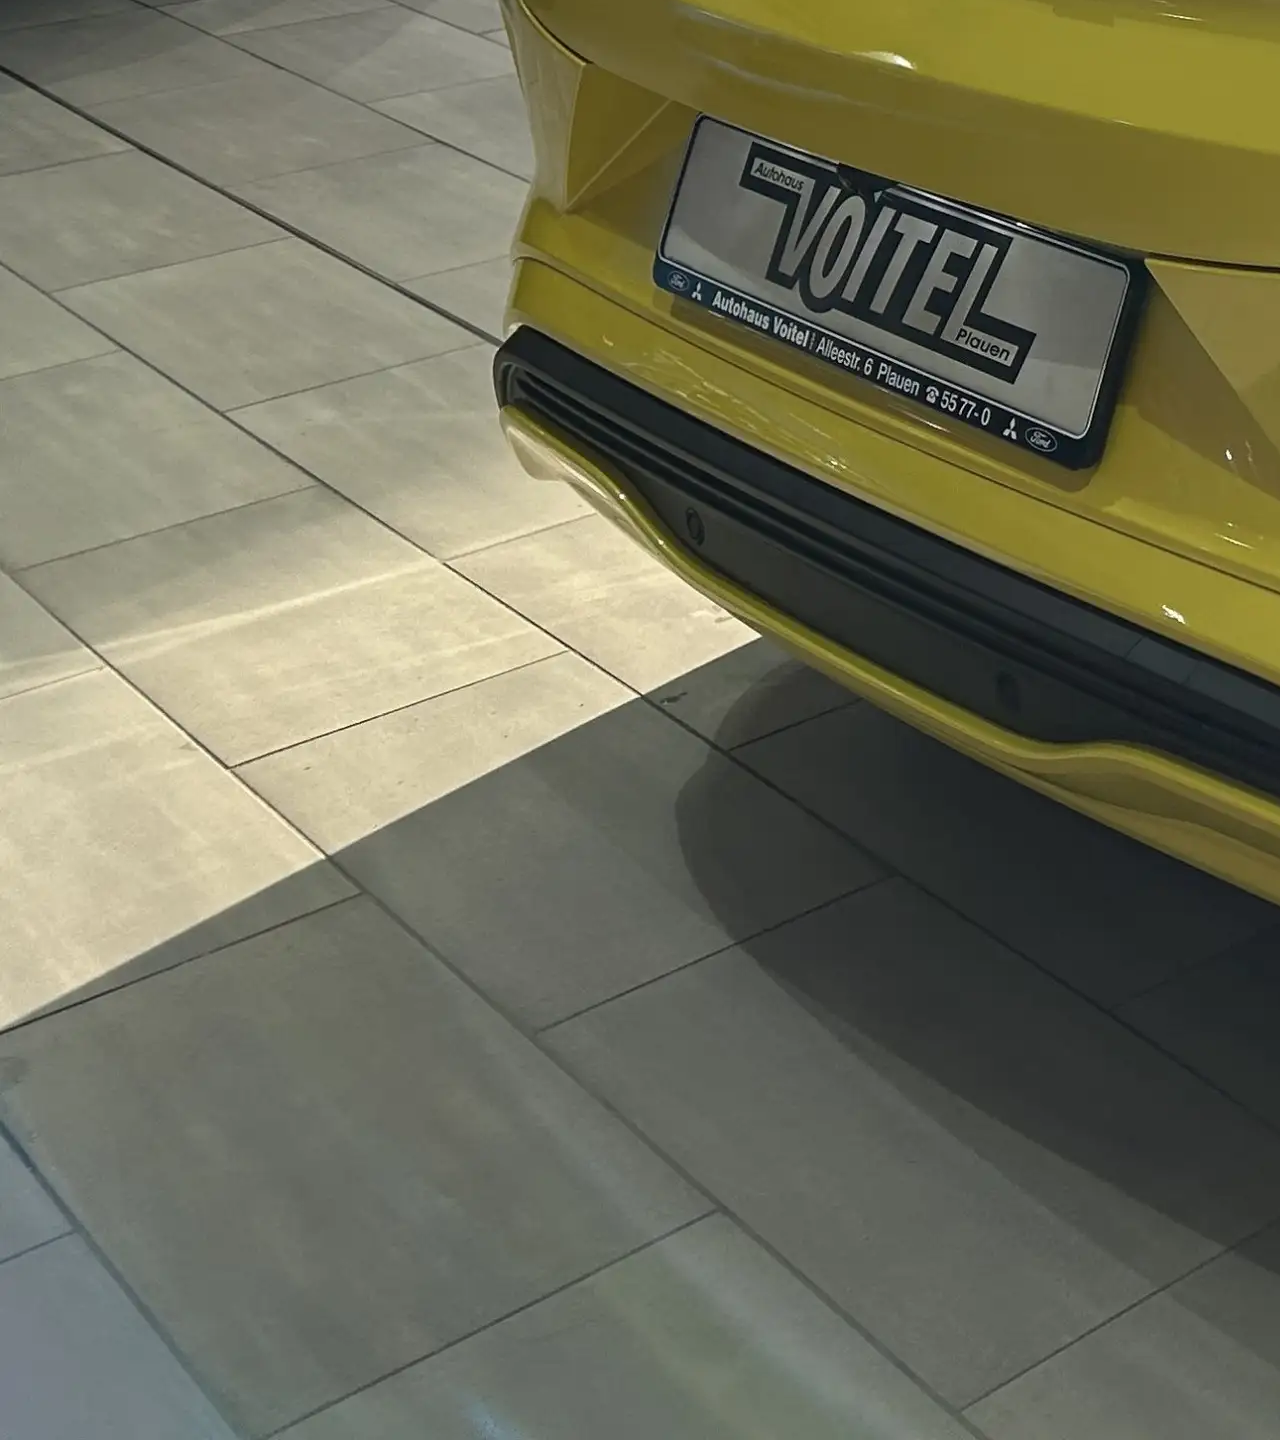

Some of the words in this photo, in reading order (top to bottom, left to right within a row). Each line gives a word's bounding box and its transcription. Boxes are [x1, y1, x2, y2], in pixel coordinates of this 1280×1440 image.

[754, 162, 805, 192] Autohaus
[762, 166, 1008, 355] VOITEL
[712, 291, 770, 330] Autohaus
[773, 316, 810, 348] Voitel
[815, 338, 860, 372] Alleestr.
[864, 357, 874, 375] 6
[876, 363, 920, 396] Plauen
[955, 327, 1011, 362] Plauen
